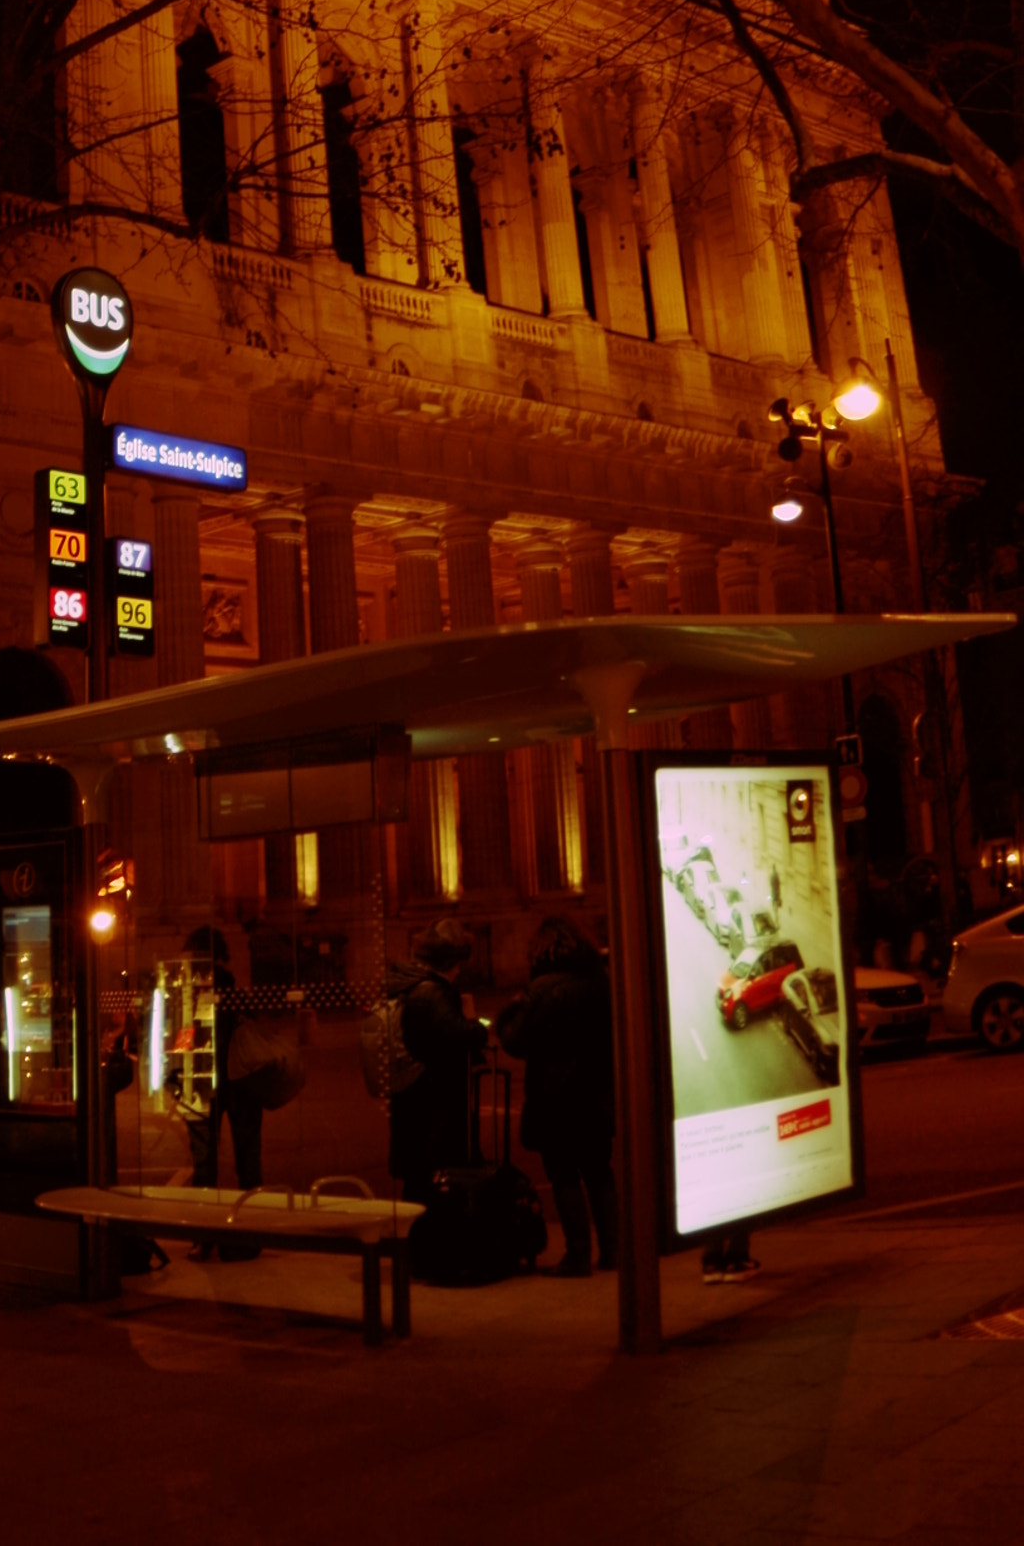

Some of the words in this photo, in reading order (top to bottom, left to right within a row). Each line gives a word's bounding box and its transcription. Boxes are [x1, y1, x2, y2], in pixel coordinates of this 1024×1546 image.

[71, 288, 124, 331] BUS
[117, 432, 157, 462] Église
[159, 444, 243, 479] Saint-Sulpice
[54, 476, 79, 499] 63
[54, 533, 81, 558] 70
[120, 541, 146, 568] 87
[54, 590, 83, 619] 86
[121, 601, 146, 625] 96
